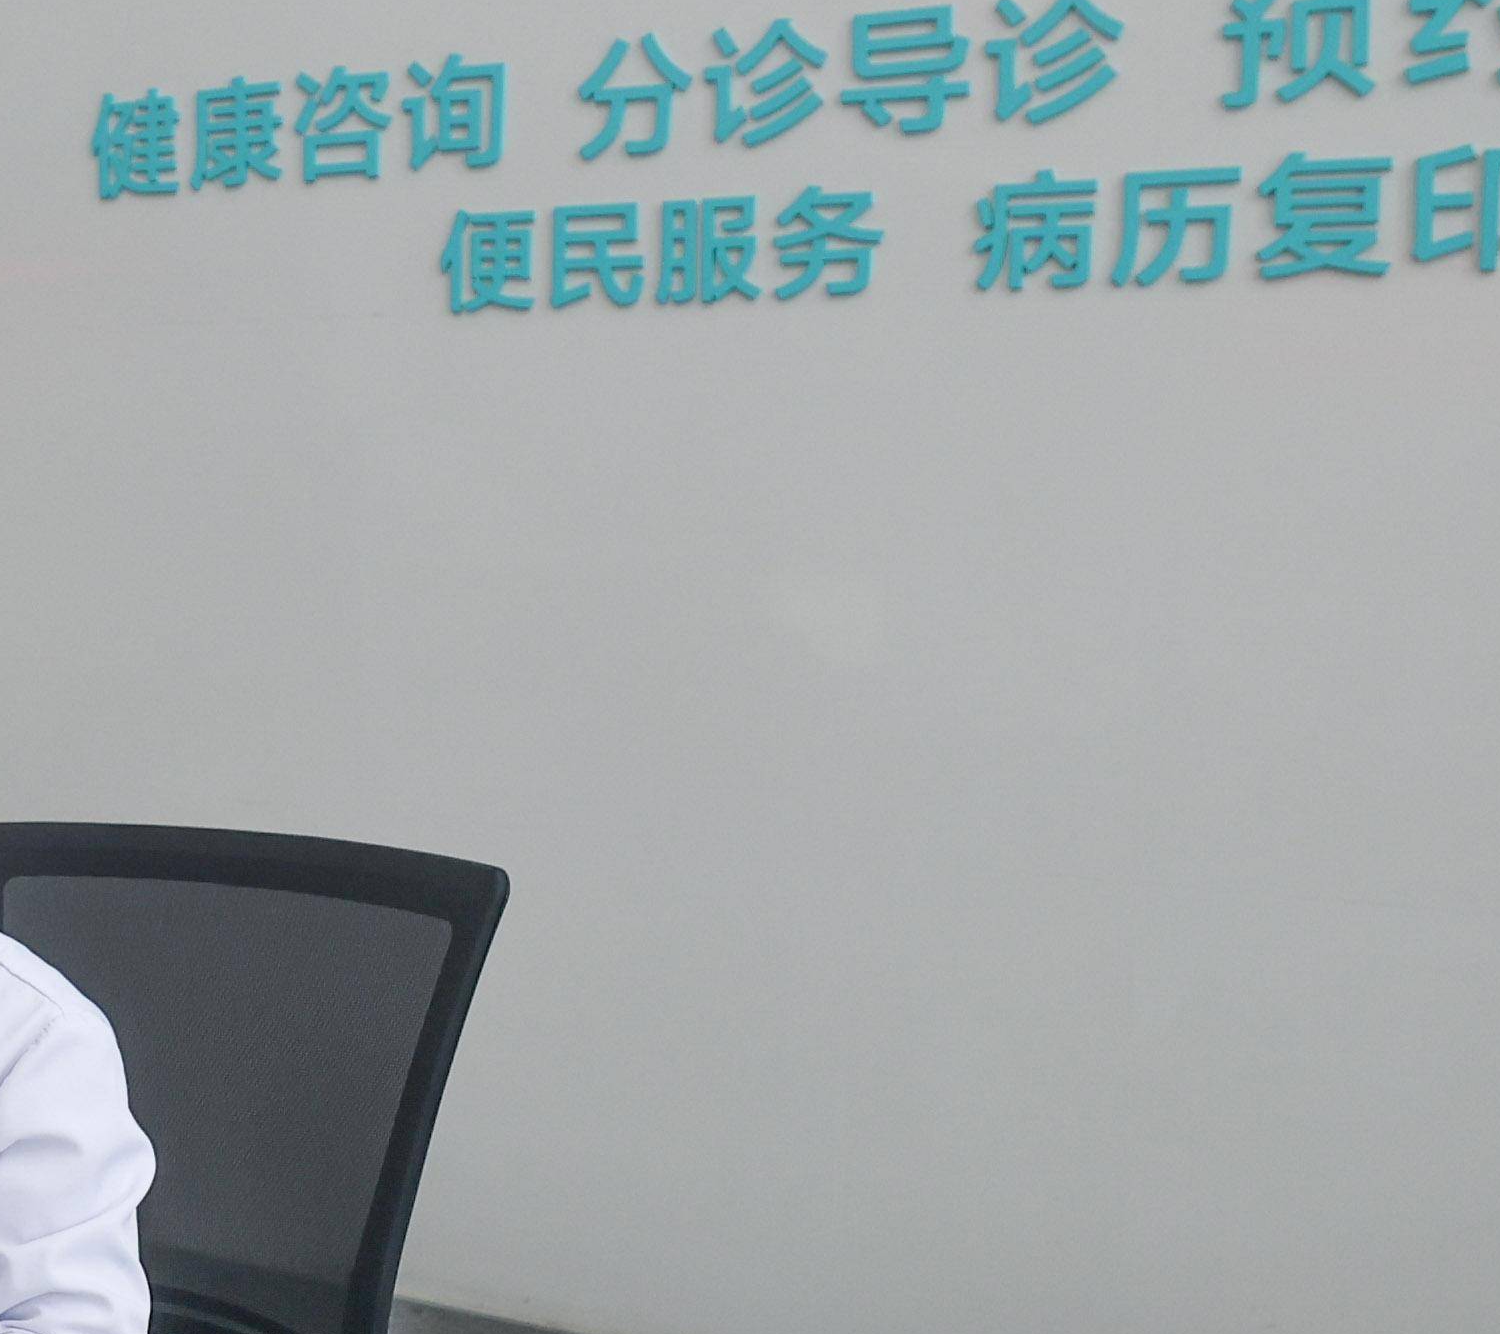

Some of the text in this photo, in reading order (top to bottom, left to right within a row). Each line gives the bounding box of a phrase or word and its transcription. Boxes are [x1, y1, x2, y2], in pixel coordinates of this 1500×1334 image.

[91, 53, 506, 200] 健康咨询
[439, 184, 885, 315] 便民服务
